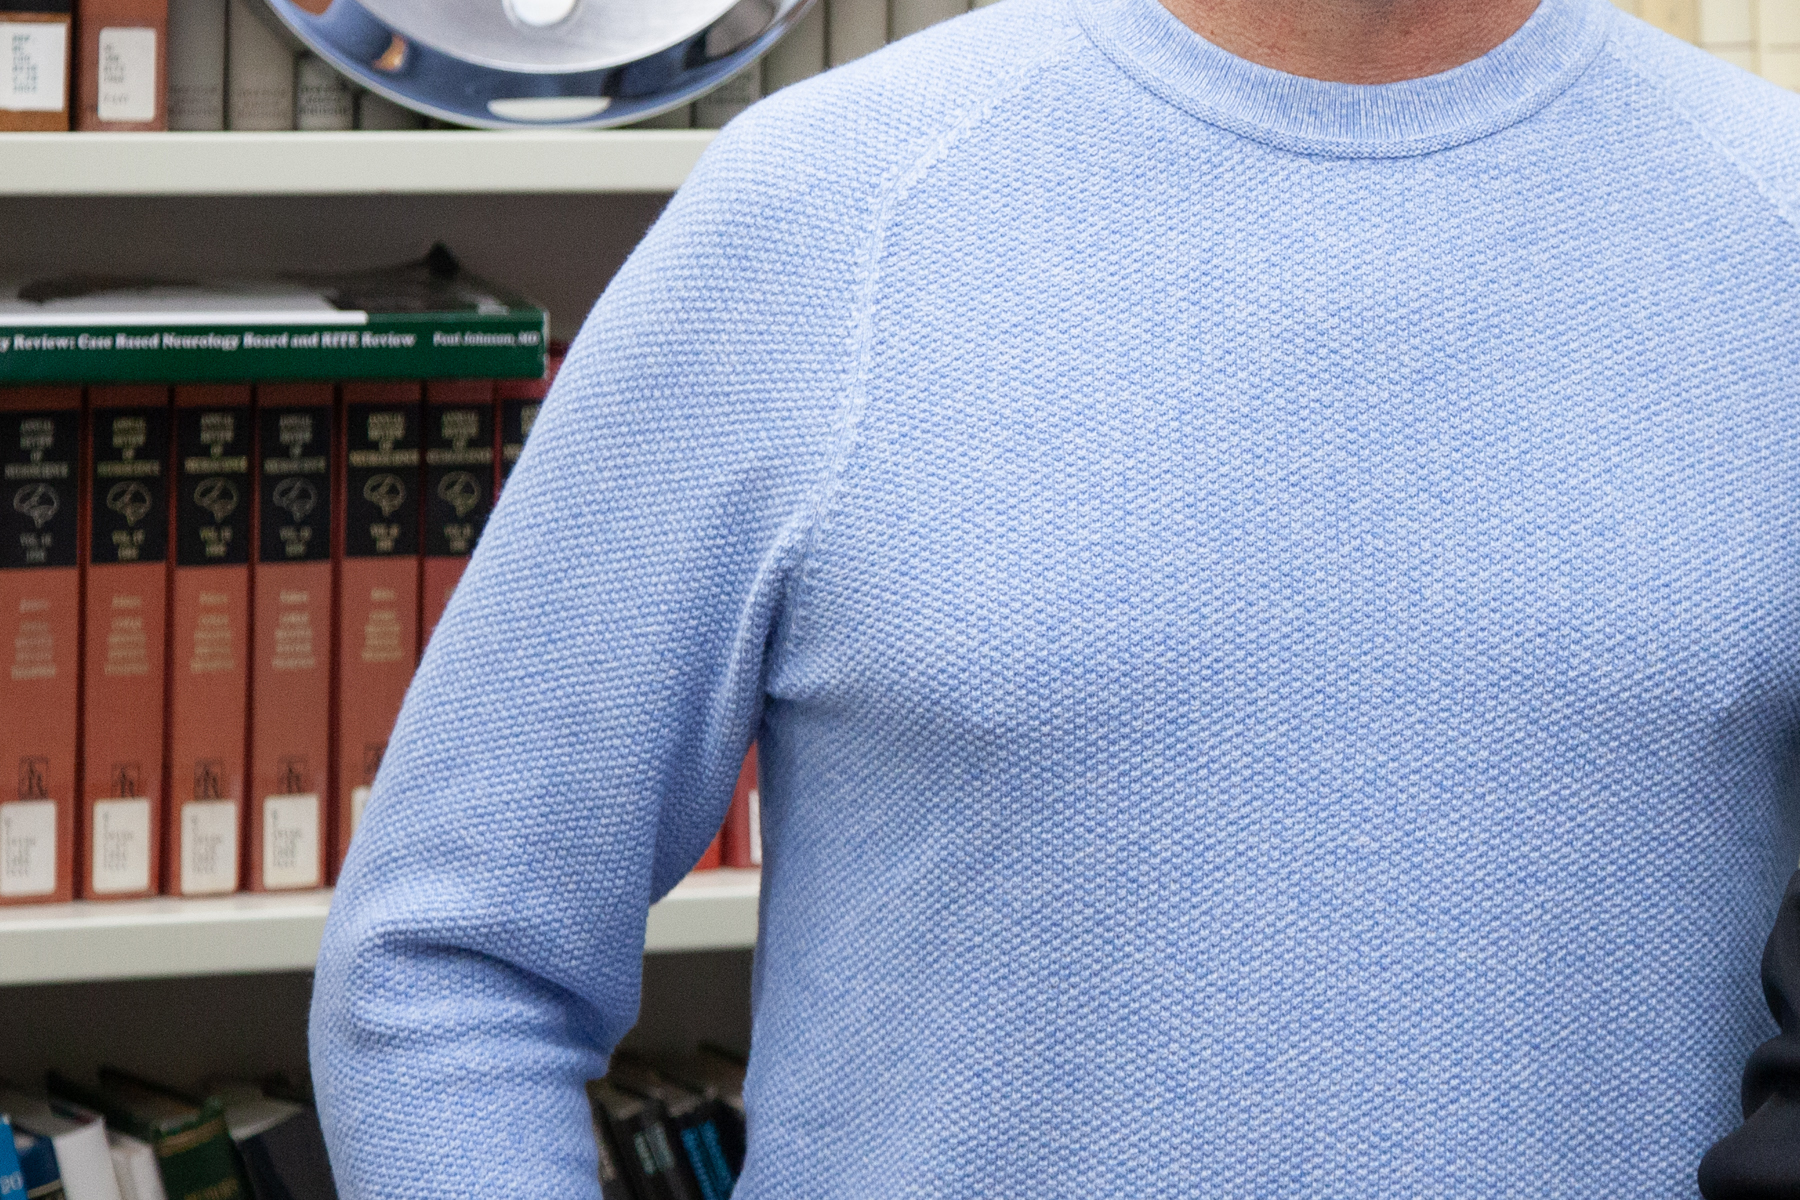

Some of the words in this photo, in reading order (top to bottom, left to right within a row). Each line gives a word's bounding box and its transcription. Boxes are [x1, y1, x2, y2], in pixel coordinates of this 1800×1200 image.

[14, 333, 76, 351] Review:
[77, 332, 114, 351] Case
[115, 332, 161, 350] Based
[161, 331, 242, 352] Neurology
[243, 331, 290, 350] Board
[290, 330, 319, 349] and
[361, 330, 417, 348] Review
